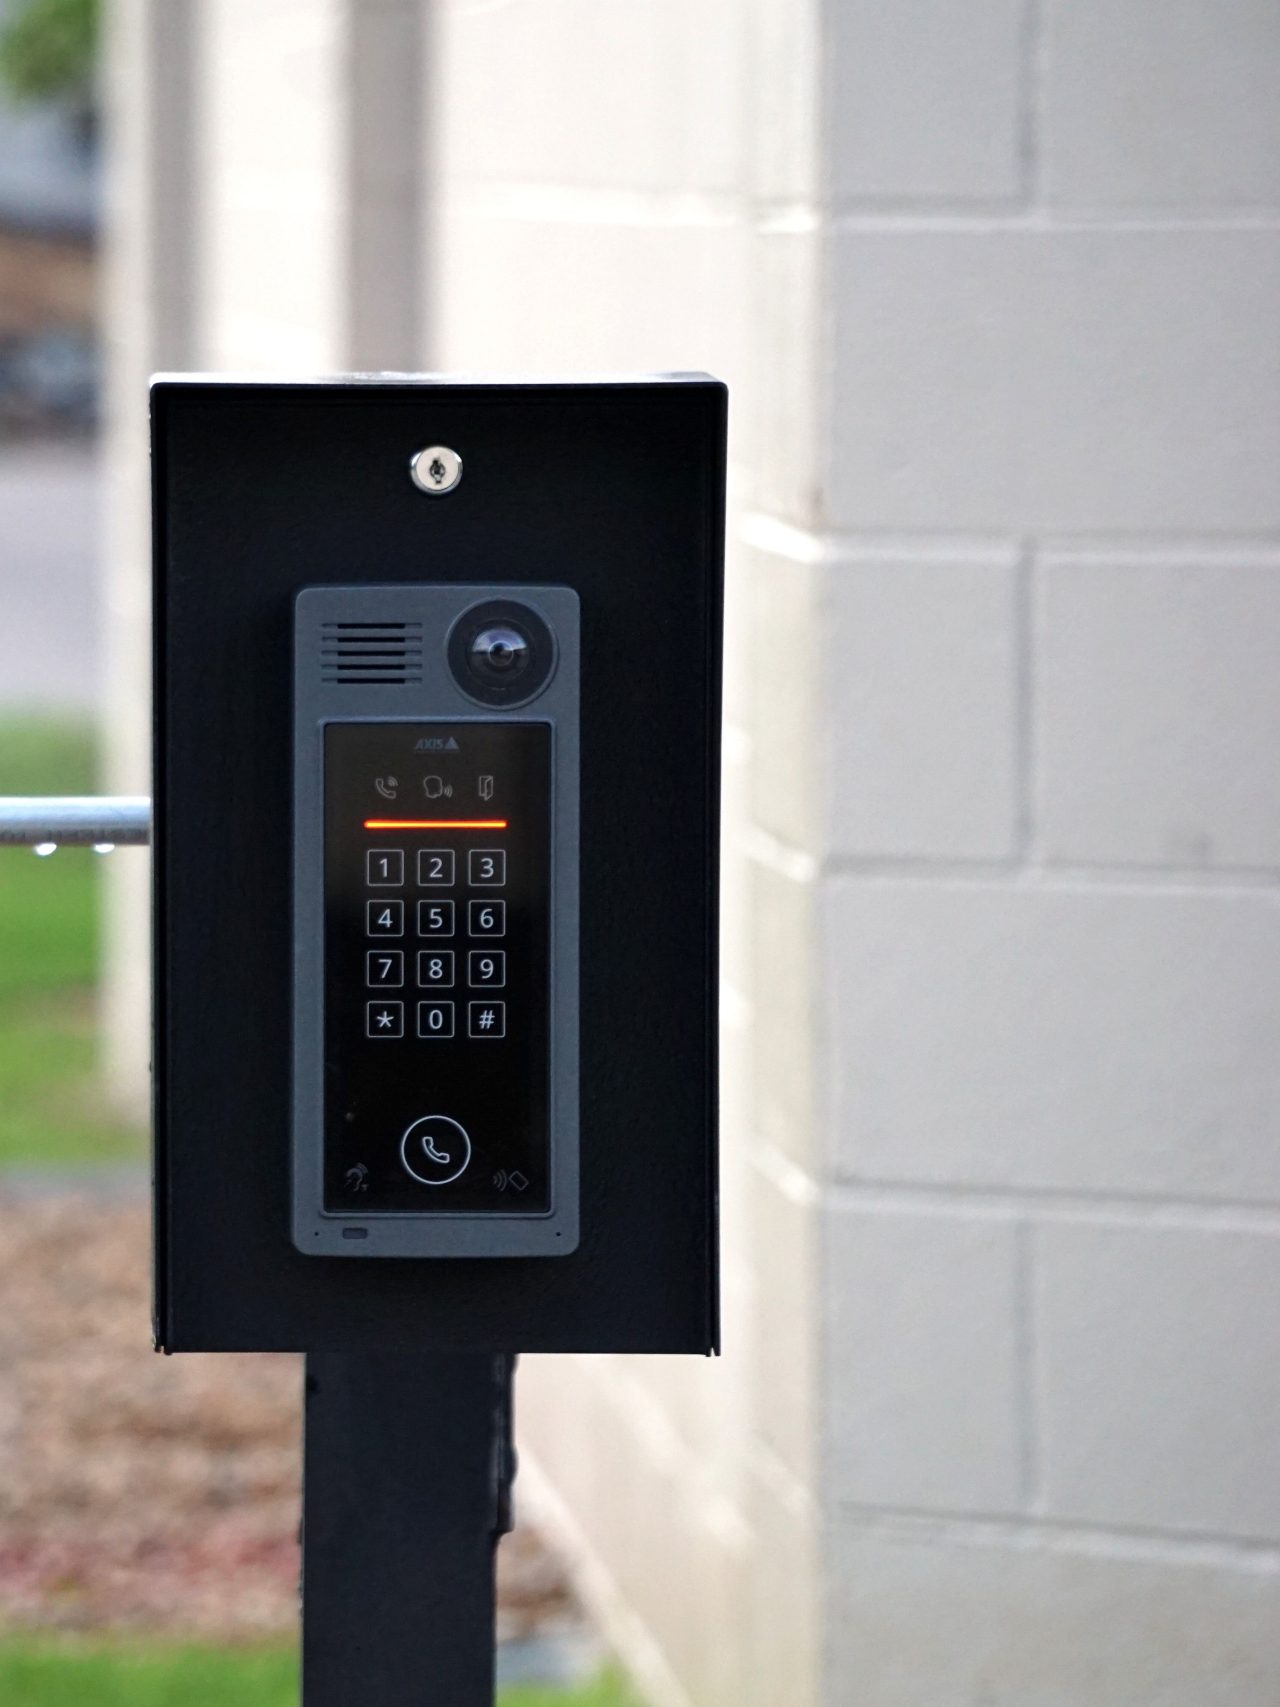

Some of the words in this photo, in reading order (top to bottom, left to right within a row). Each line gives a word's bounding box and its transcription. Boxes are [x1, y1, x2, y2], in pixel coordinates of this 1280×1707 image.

[379, 858, 388, 877] 1
[429, 858, 443, 877] 2
[480, 858, 494, 877] 3
[378, 908, 393, 928] 4
[429, 908, 443, 928] 5
[480, 908, 494, 928] 6
[378, 959, 392, 978] 7
[429, 959, 443, 979] 8
[480, 959, 494, 978] 9
[429, 1009, 443, 1029] 0
[479, 1010, 495, 1029] #
